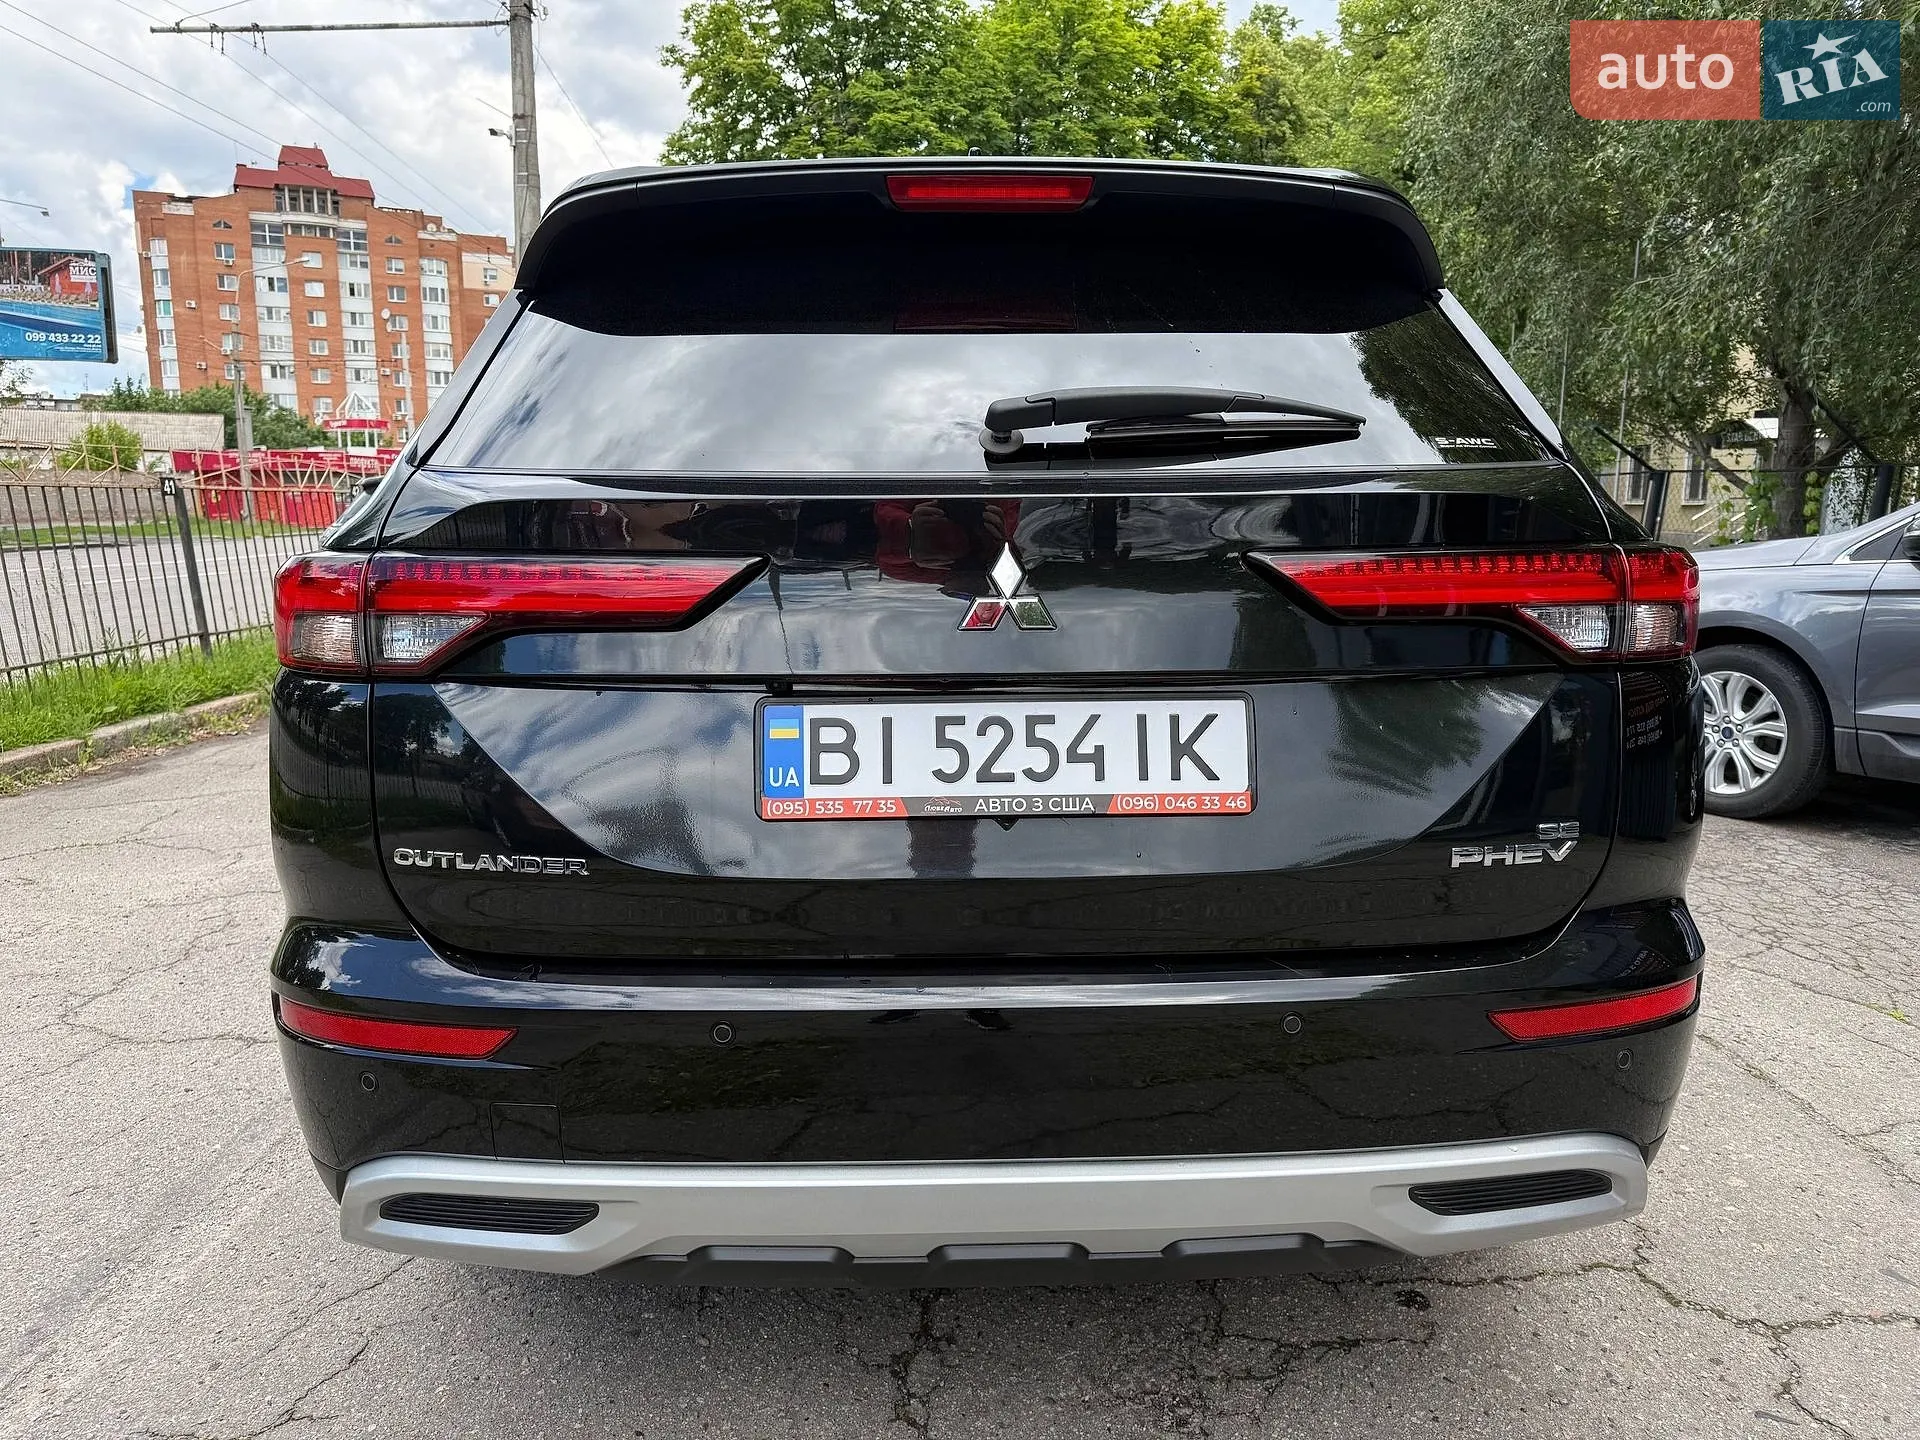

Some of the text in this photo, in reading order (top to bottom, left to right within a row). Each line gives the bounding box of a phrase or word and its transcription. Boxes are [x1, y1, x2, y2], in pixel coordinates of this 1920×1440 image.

[25, 332, 102, 344] 099 433 22 22
[1435, 437, 1495, 446] S-AWC
[931, 713, 1105, 784] 5254
[769, 766, 800, 788] UA
[766, 798, 897, 816] (095) 535 77 35
[974, 798, 1027, 813] АВТО
[1048, 796, 1095, 812] США
[1116, 794, 1247, 812] (096) 046 33 46
[1537, 821, 1580, 840] SE
[394, 847, 590, 876] OUTLANDER
[1450, 840, 1579, 868] PHEV
